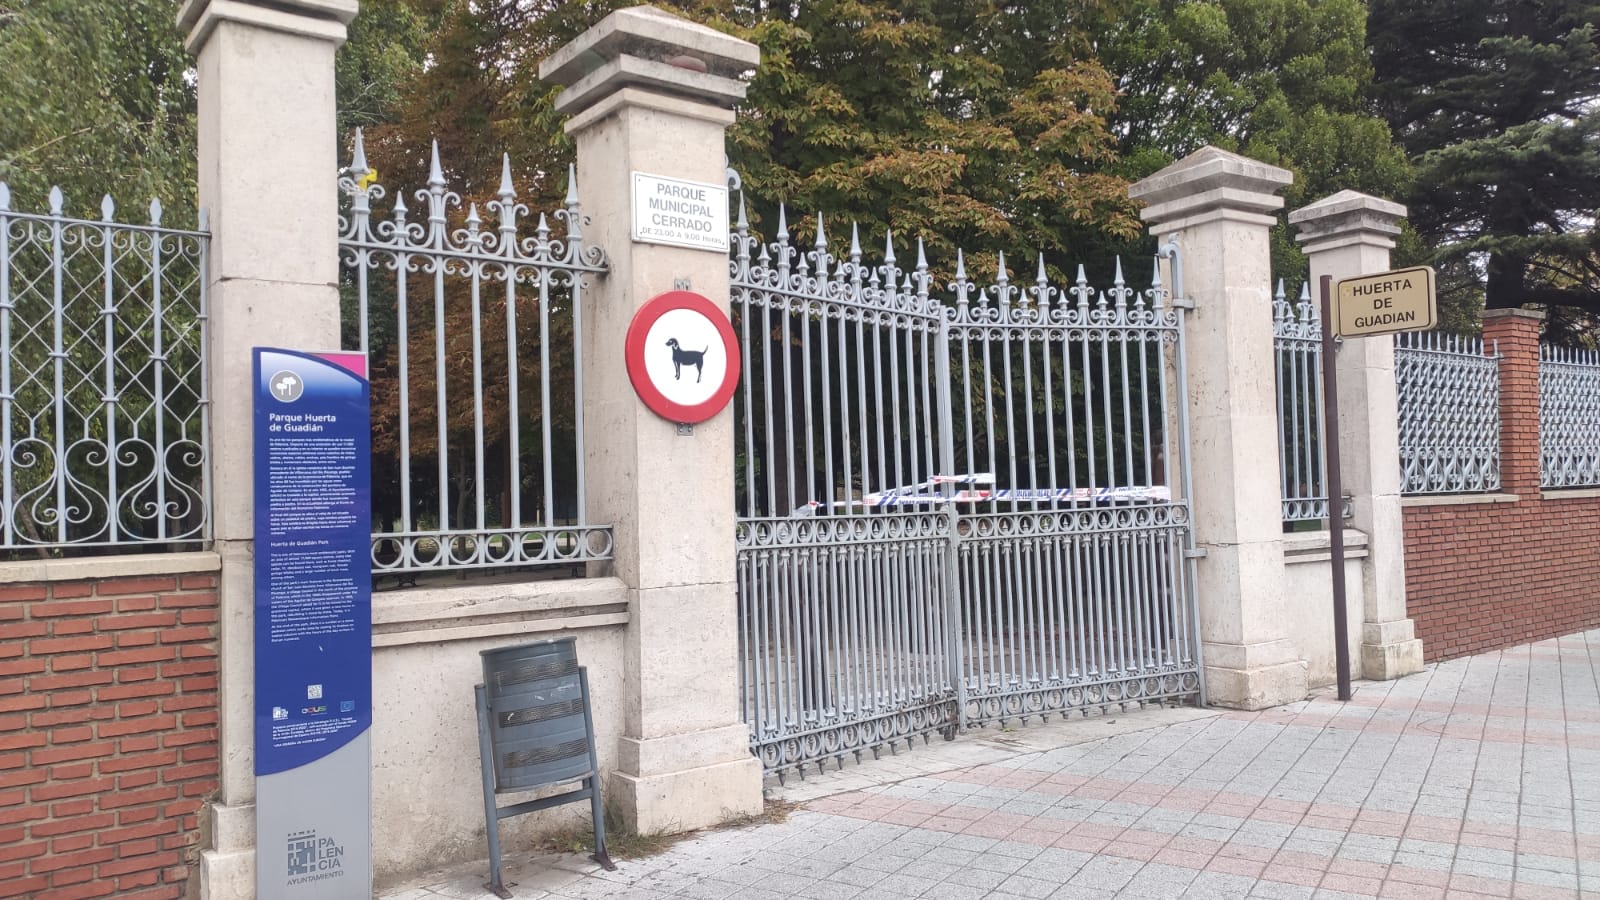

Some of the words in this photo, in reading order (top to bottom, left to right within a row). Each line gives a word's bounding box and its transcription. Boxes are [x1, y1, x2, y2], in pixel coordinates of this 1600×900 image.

[657, 183, 706, 201] PARQUE
[649, 197, 714, 218] MUNICIPAL
[652, 213, 712, 232] CERRADO
[642, 226, 652, 234] DE
[676, 231, 682, 239] A
[1353, 279, 1412, 296] HUERTA
[1373, 297, 1393, 310] DE
[1354, 311, 1415, 328] GUADIAN
[269, 413, 303, 423] Parque
[304, 413, 337, 422] Huerta
[269, 423, 282, 432] de
[283, 423, 323, 432] Guadián
[318, 837, 335, 848] PA
[318, 845, 344, 859] LEN
[318, 858, 341, 870] CIA
[286, 870, 344, 886] AYUNTAMIENTO
